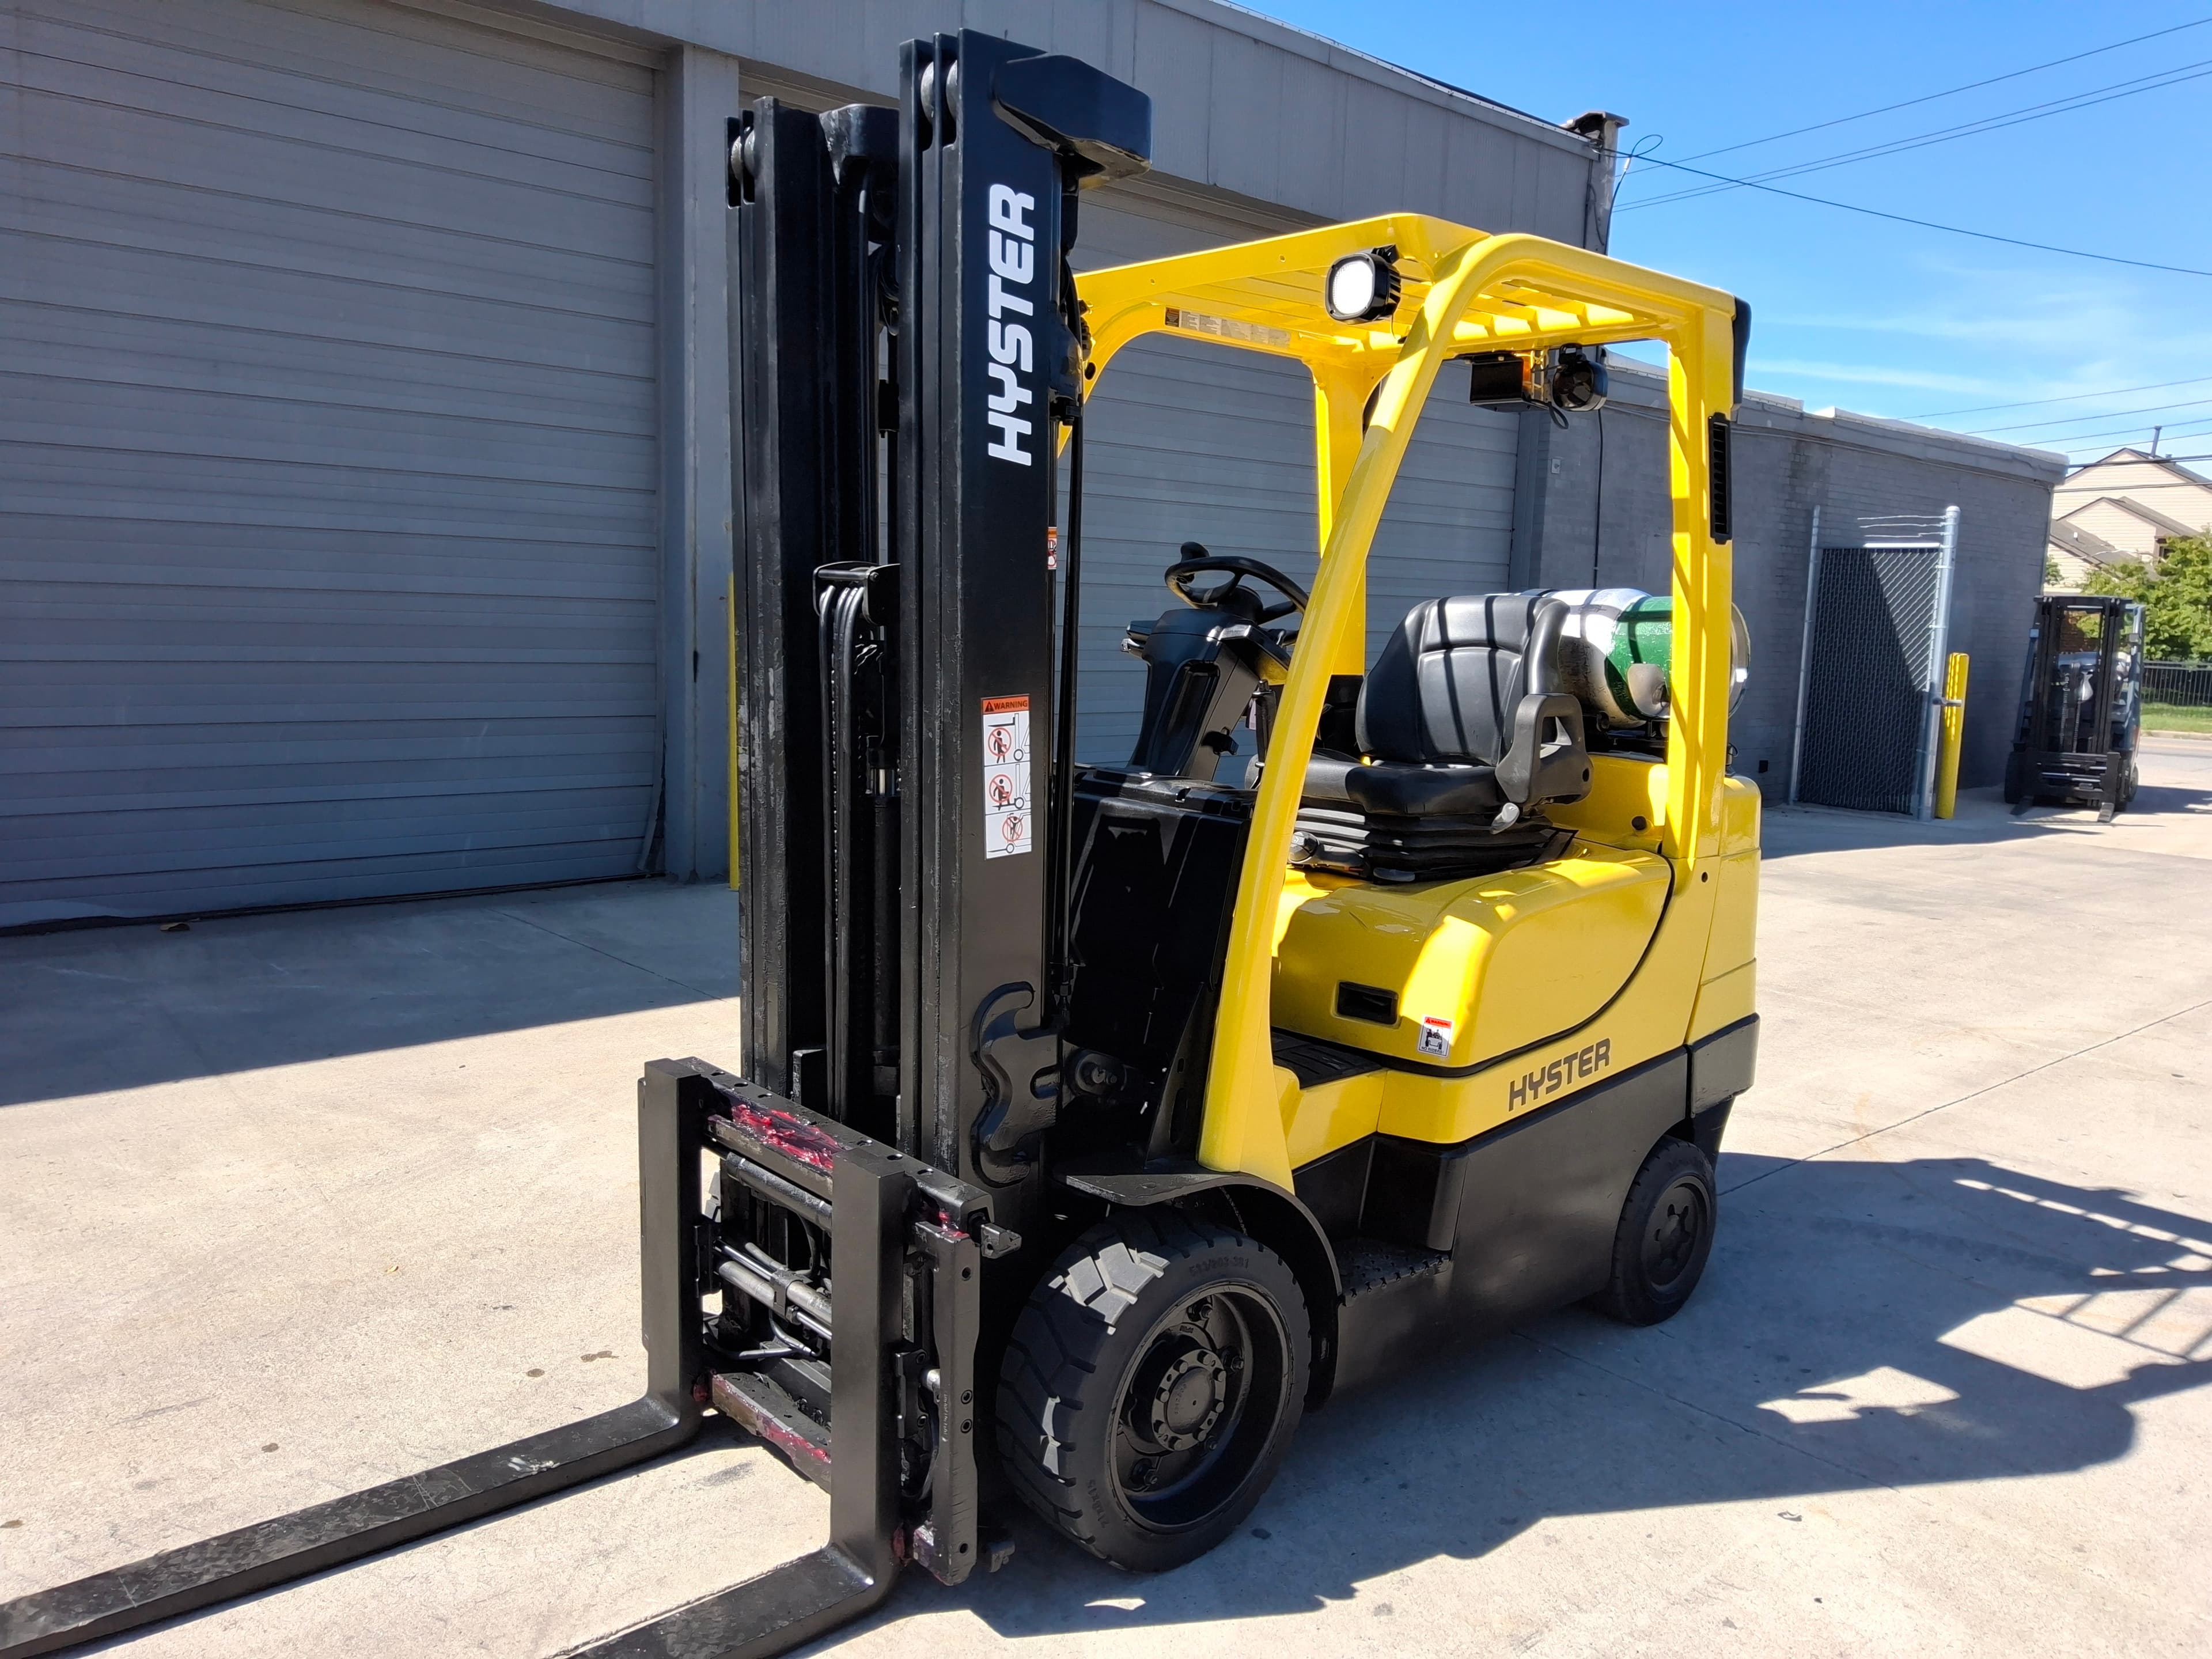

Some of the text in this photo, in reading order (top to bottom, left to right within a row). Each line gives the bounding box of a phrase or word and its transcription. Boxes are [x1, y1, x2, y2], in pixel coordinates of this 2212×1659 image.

[988, 184, 1035, 467] HYSTER
[994, 700, 1028, 710] WARNING
[1509, 1038, 1610, 1111] HYSTER
